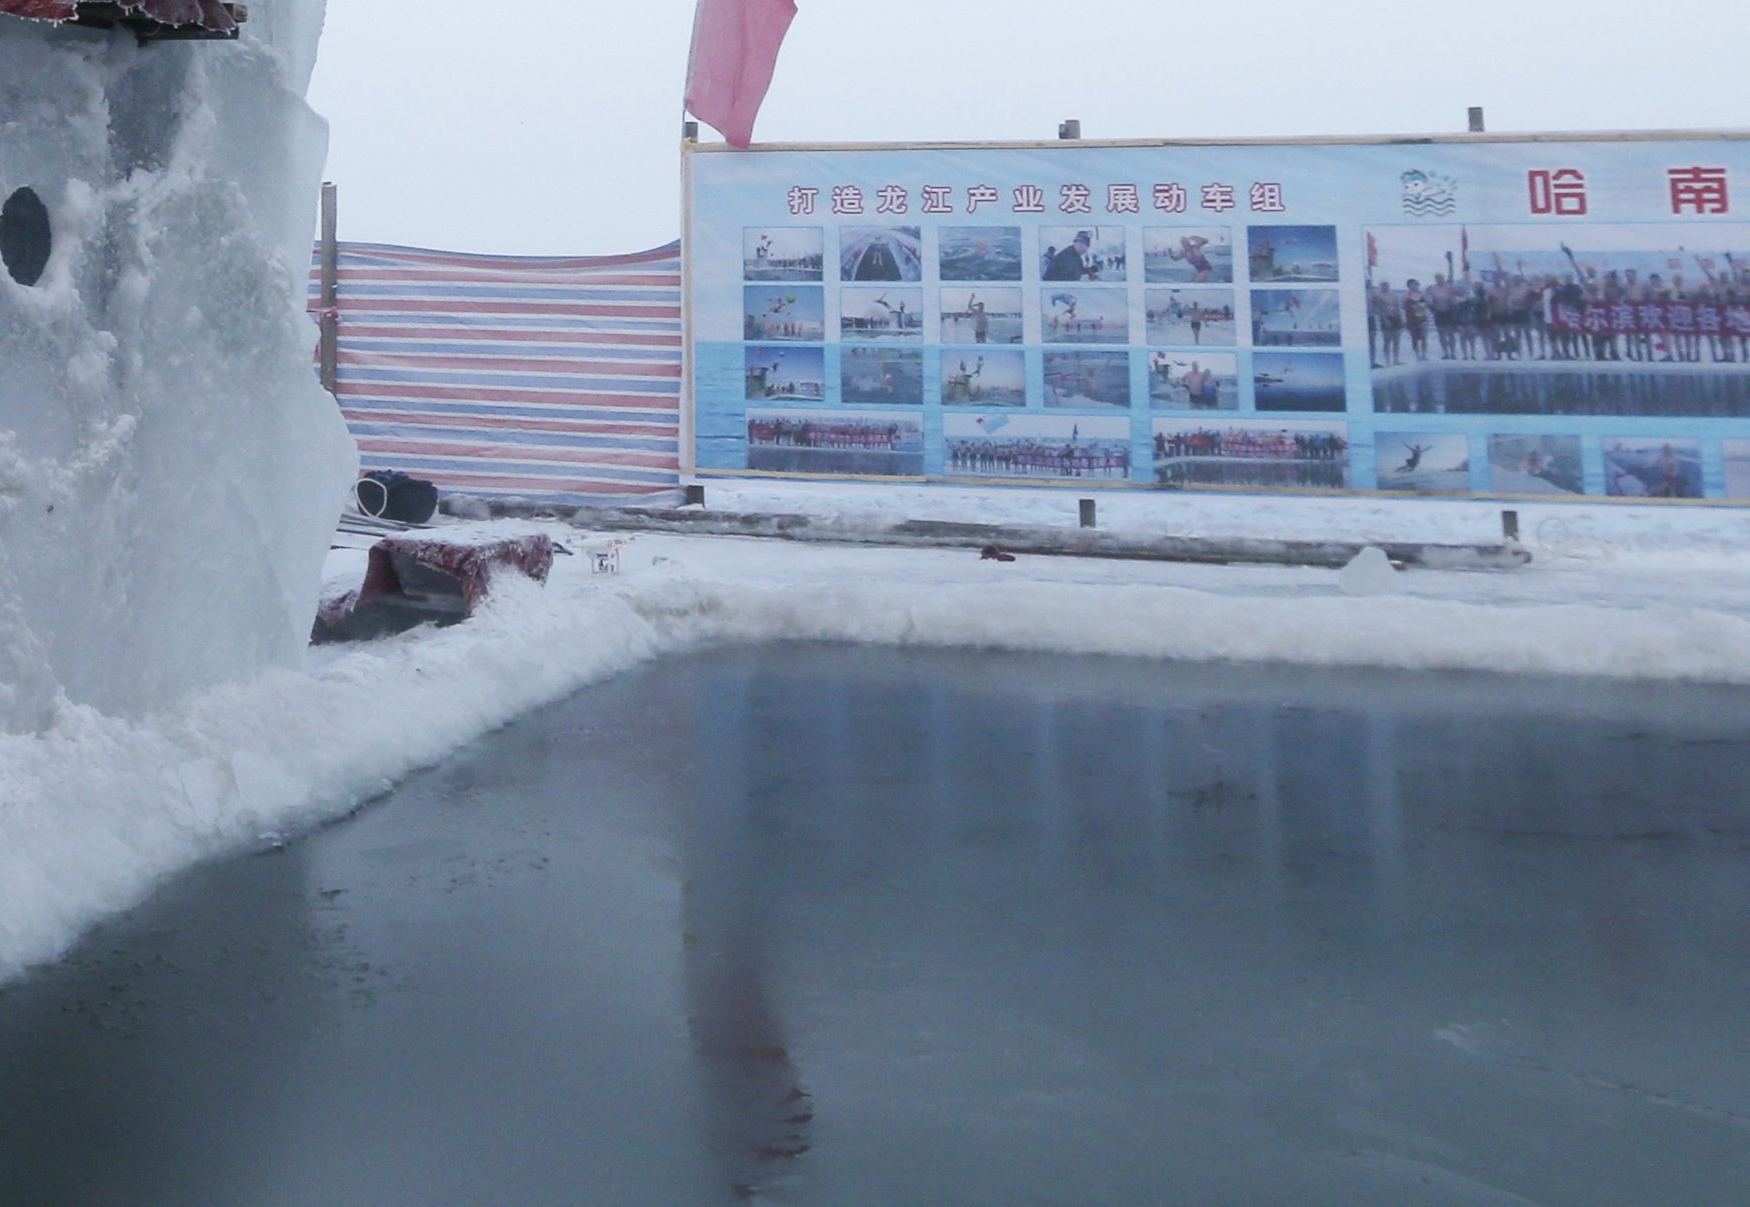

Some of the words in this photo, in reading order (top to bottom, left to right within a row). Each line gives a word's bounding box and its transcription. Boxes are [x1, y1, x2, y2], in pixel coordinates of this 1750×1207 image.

[787, 182, 1286, 214] 打造龙江产业发展动车组
[1527, 166, 1730, 216] 哈南
